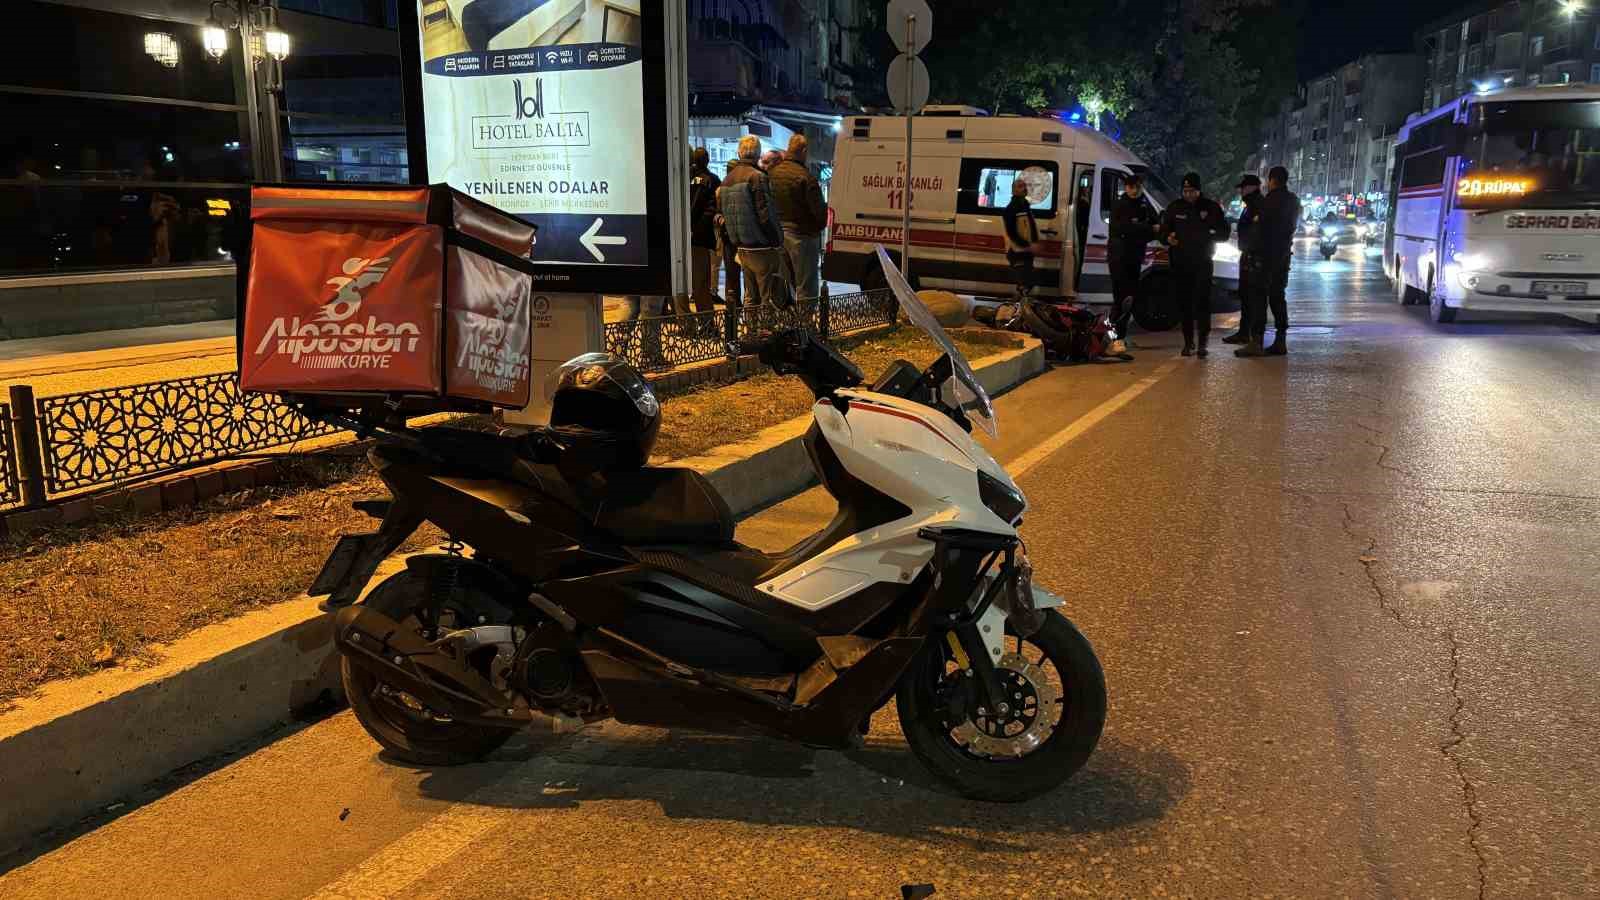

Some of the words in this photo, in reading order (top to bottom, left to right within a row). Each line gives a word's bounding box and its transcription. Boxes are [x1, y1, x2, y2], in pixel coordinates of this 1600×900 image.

[480, 124, 531, 140] HOTEL
[536, 121, 584, 138] BALTA
[464, 178, 543, 195] YENİLENEN
[548, 180, 609, 194] ODALAR
[862, 173, 894, 189] SAĞLIK
[1506, 215, 1569, 229] SERHAD
[254, 315, 421, 363] Alpaslan
